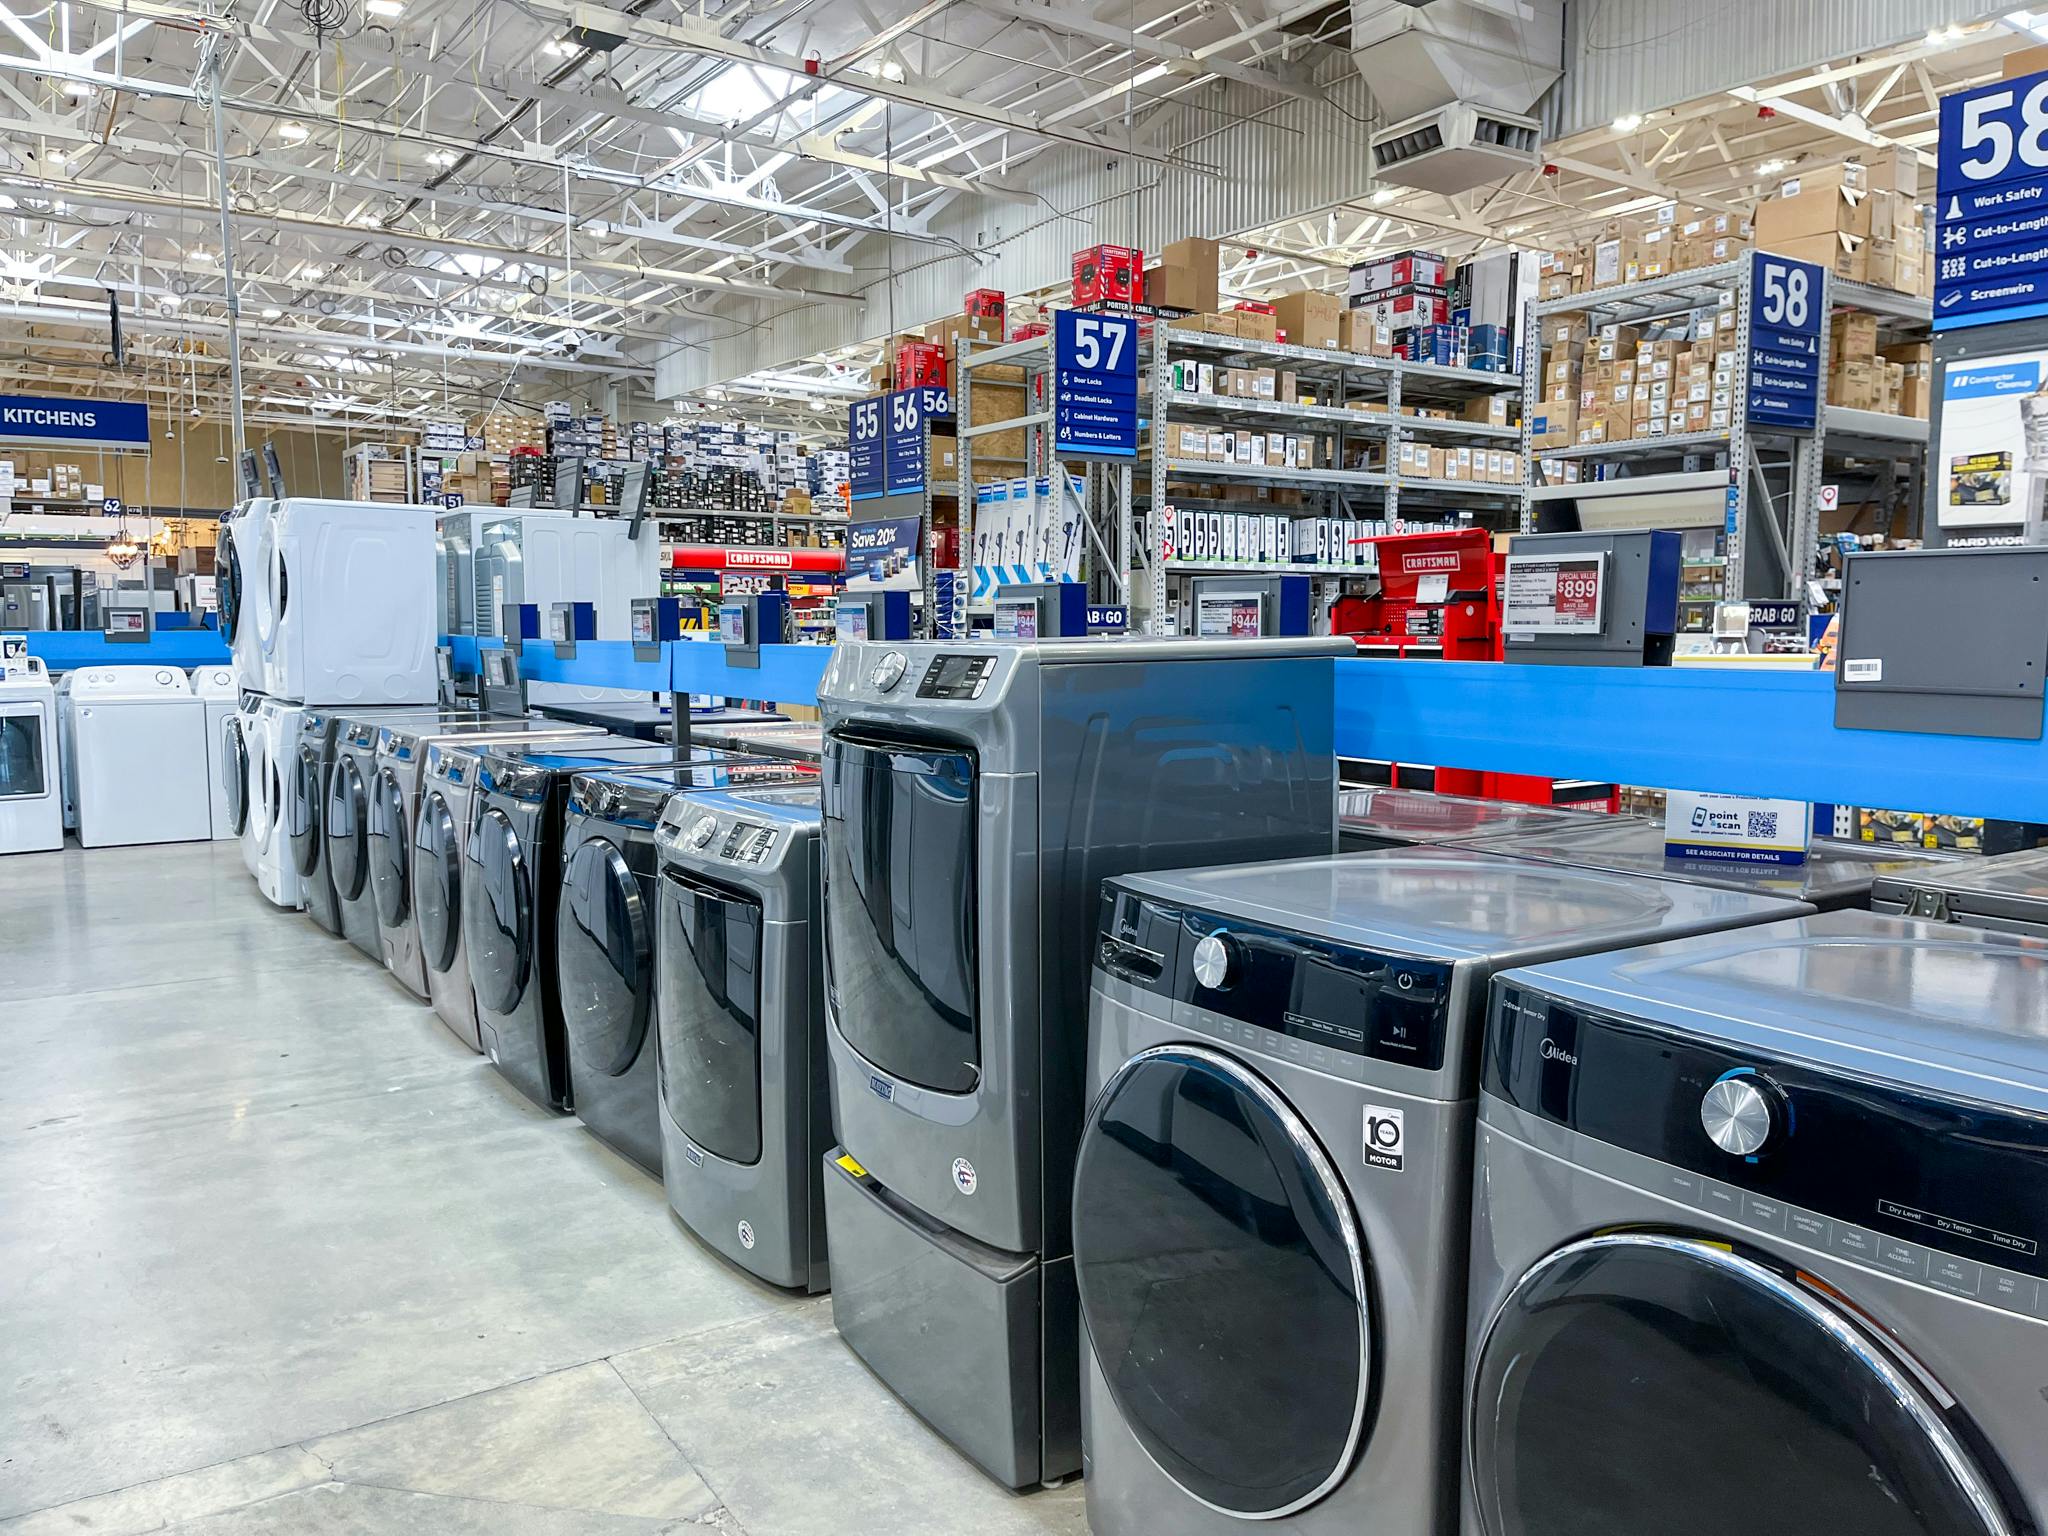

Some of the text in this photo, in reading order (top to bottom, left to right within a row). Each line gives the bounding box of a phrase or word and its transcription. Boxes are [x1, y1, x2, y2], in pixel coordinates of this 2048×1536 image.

[1974, 186, 2042, 208] Work Safety
[1360, 288, 1402, 304] PORTER CABLE
[1763, 263, 1808, 327] 58
[1971, 282, 2034, 300] Screenwire
[1107, 301, 1153, 314] PORTER CABLE
[1075, 318, 1127, 370] 57
[1074, 376, 1102, 386] Door Locks
[1969, 374, 2015, 384] Contractor
[923, 390, 948, 413] 56
[1074, 394, 1113, 405] Deadbolt Locks
[3, 408, 97, 427] KITCHENS
[894, 393, 918, 432] 56
[1074, 412, 1119, 423] Cabinet Hardware
[856, 402, 878, 440] 55
[1074, 431, 1097, 439] Numbers
[103, 499, 121, 512] 62
[448, 496, 462, 508] 51
[851, 526, 898, 548] Save 20%
[1947, 535, 2029, 547] HARD WOR
[730, 553, 790, 564] CRAFTSMAN
[1406, 556, 1457, 569] CRAFTSMAN
[1557, 580, 1596, 598] $899
[1087, 611, 1099, 623] AB
[1105, 611, 1122, 624] GO
[1232, 614, 1257, 629] $944
[1749, 608, 1776, 623] GRAB
[1781, 608, 1796, 623] GO
[1709, 811, 1738, 821] point
[1699, 849, 1736, 859] ASSOCIATE
[1751, 853, 1780, 861] DETAILS
[1537, 1012, 1546, 1021] Dry
[1540, 1038, 1578, 1065] Midea
[1367, 1116, 1400, 1147] 10
[1370, 1154, 1397, 1166] MOTOR
[1752, 1201, 1777, 1214] WRINKLE
[1889, 1205, 2027, 1249] Dry Level Dry Temp Time Dry
